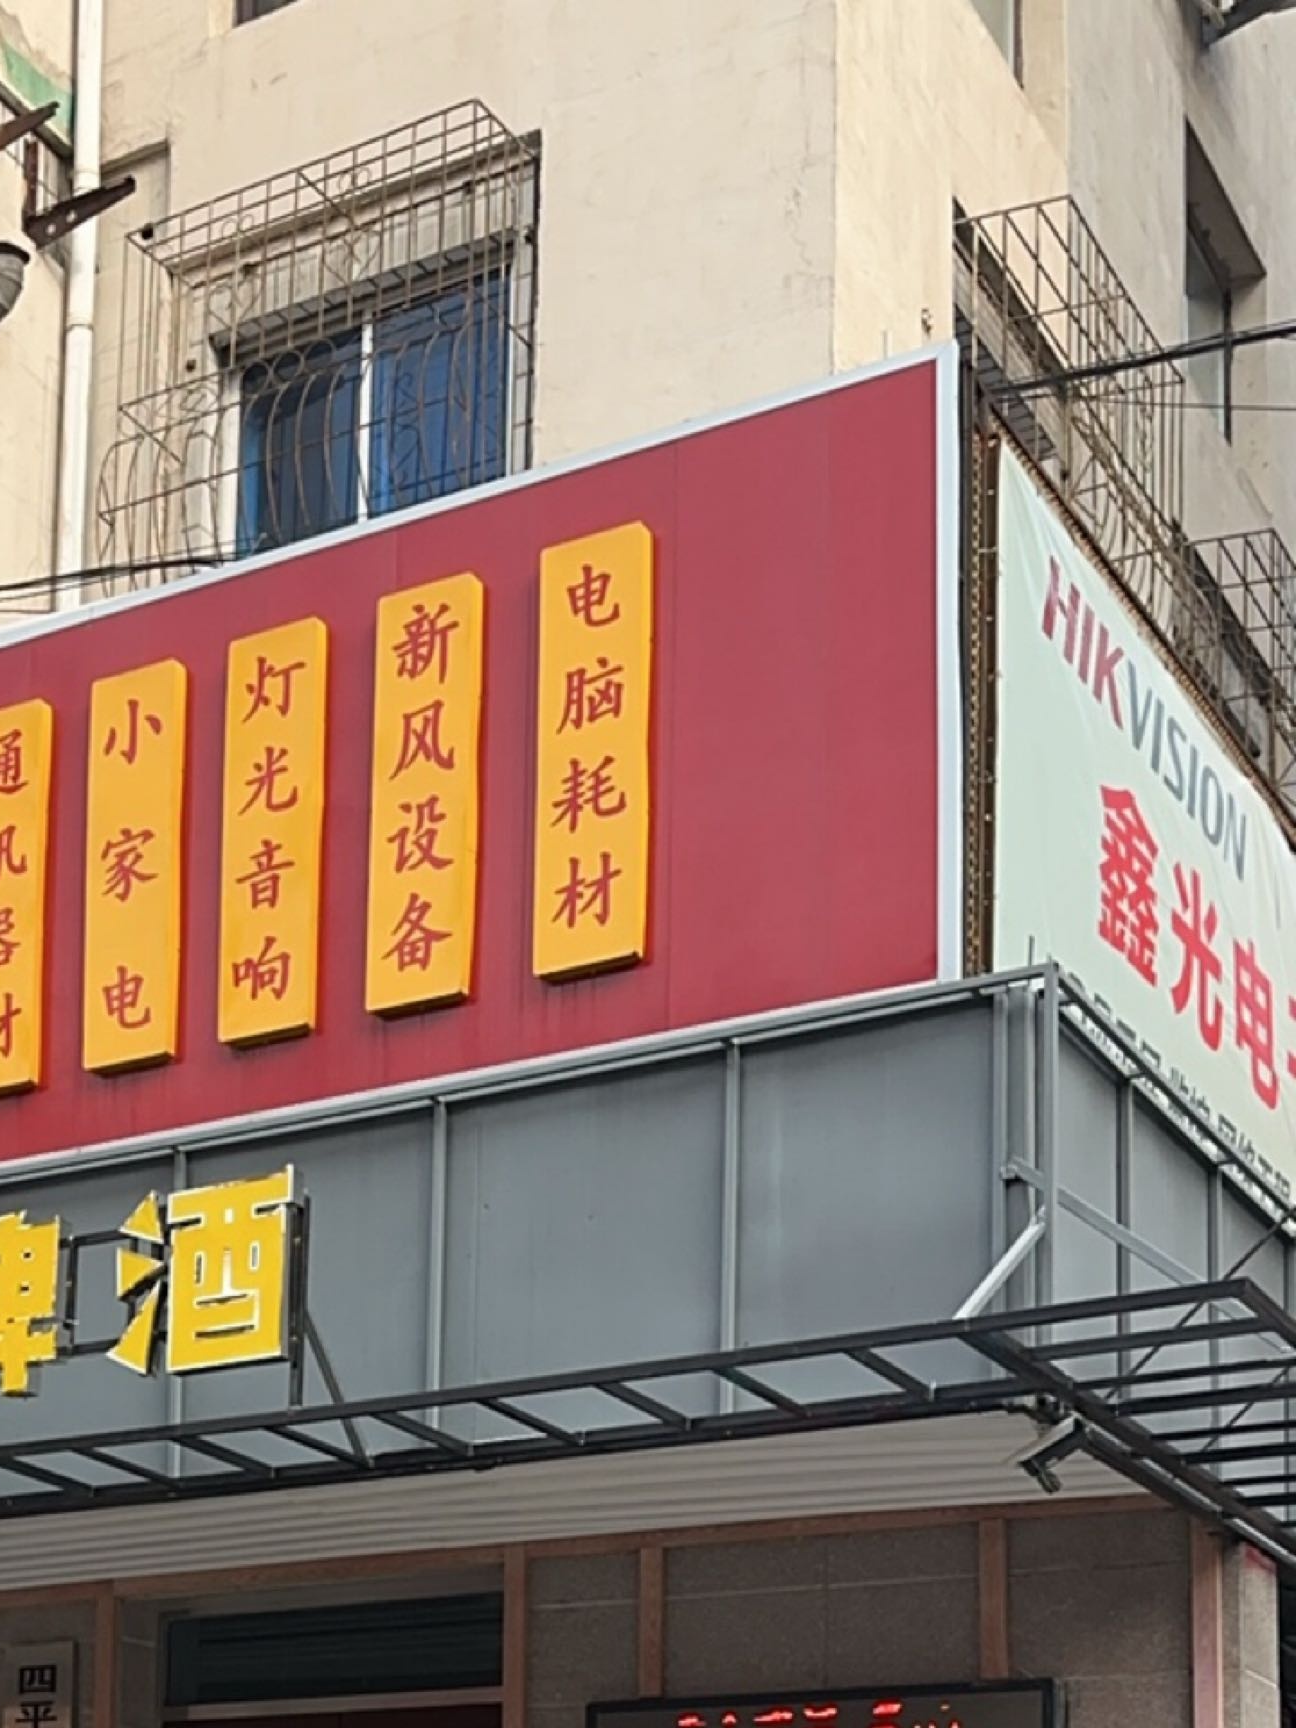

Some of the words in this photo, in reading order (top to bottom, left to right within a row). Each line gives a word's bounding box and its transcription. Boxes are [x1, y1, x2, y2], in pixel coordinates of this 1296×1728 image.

[100, 699, 163, 1030] 小家电
[232, 655, 307, 1000] 灯光音响
[382, 603, 460, 972] 新风设备
[552, 564, 627, 929] 电脑耗材
[1042, 555, 1247, 882] HIKVISION
[1099, 785, 1296, 1110] 鑫光电
